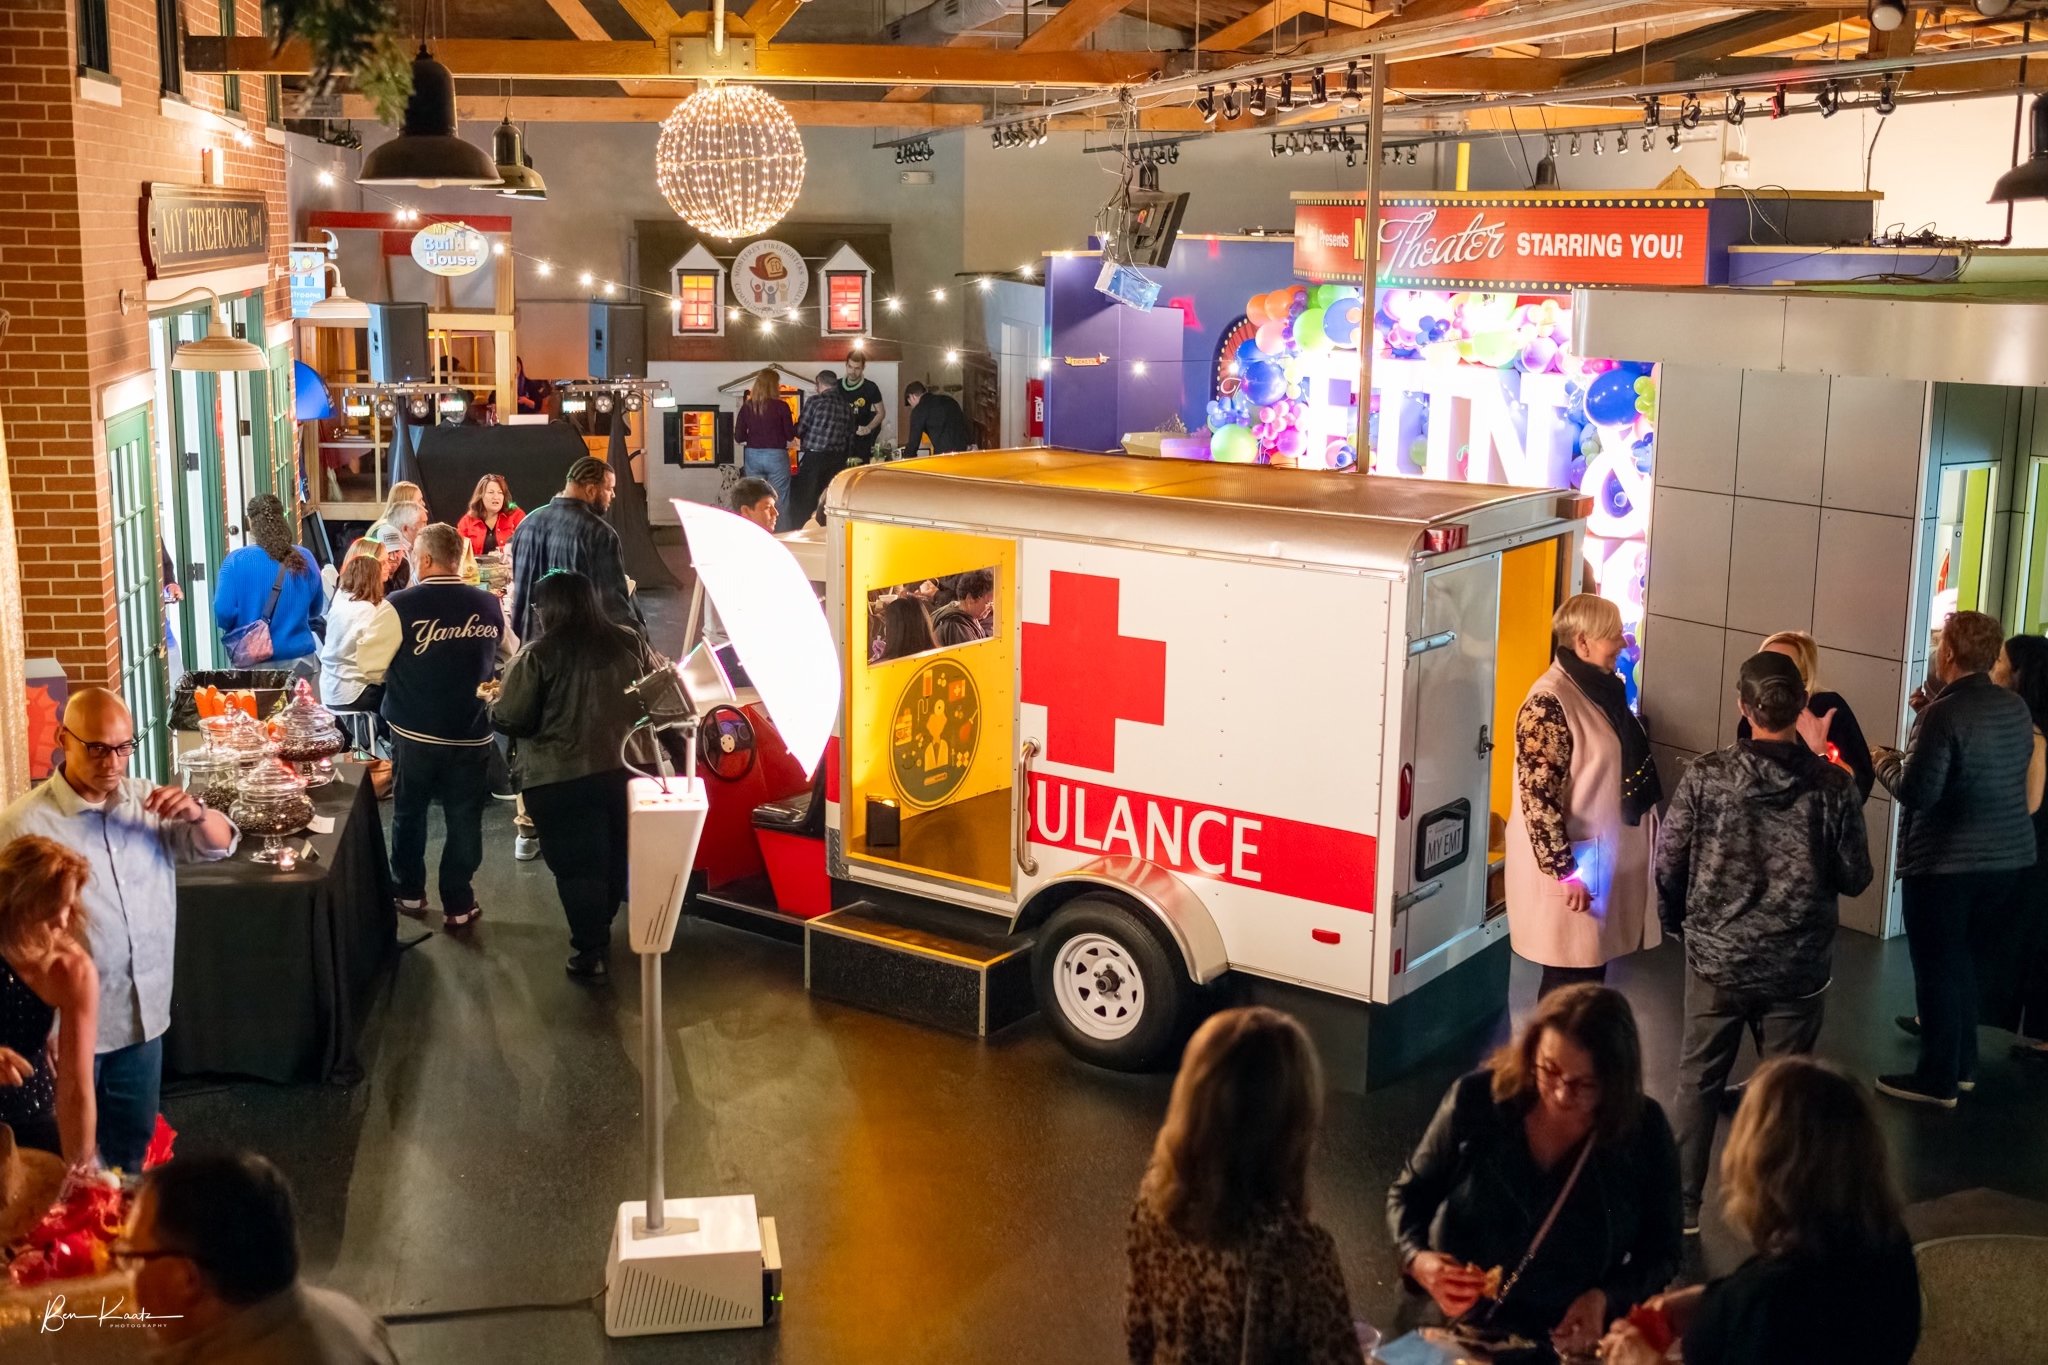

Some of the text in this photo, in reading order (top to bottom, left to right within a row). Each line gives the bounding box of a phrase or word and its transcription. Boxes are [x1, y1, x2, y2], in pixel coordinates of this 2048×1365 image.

[162, 207, 183, 254] MY
[187, 207, 249, 252] FIREHOUSE
[423, 232, 466, 251] Build
[1320, 229, 1349, 248] Presents
[1378, 209, 1506, 281] Theater
[1517, 232, 1622, 258] STARRING
[1630, 233, 1684, 259] YOU!
[426, 250, 477, 266] House
[411, 614, 499, 656] Yankees
[1029, 780, 1262, 882] ULANCE
[1427, 828, 1461, 864] MY EMT
